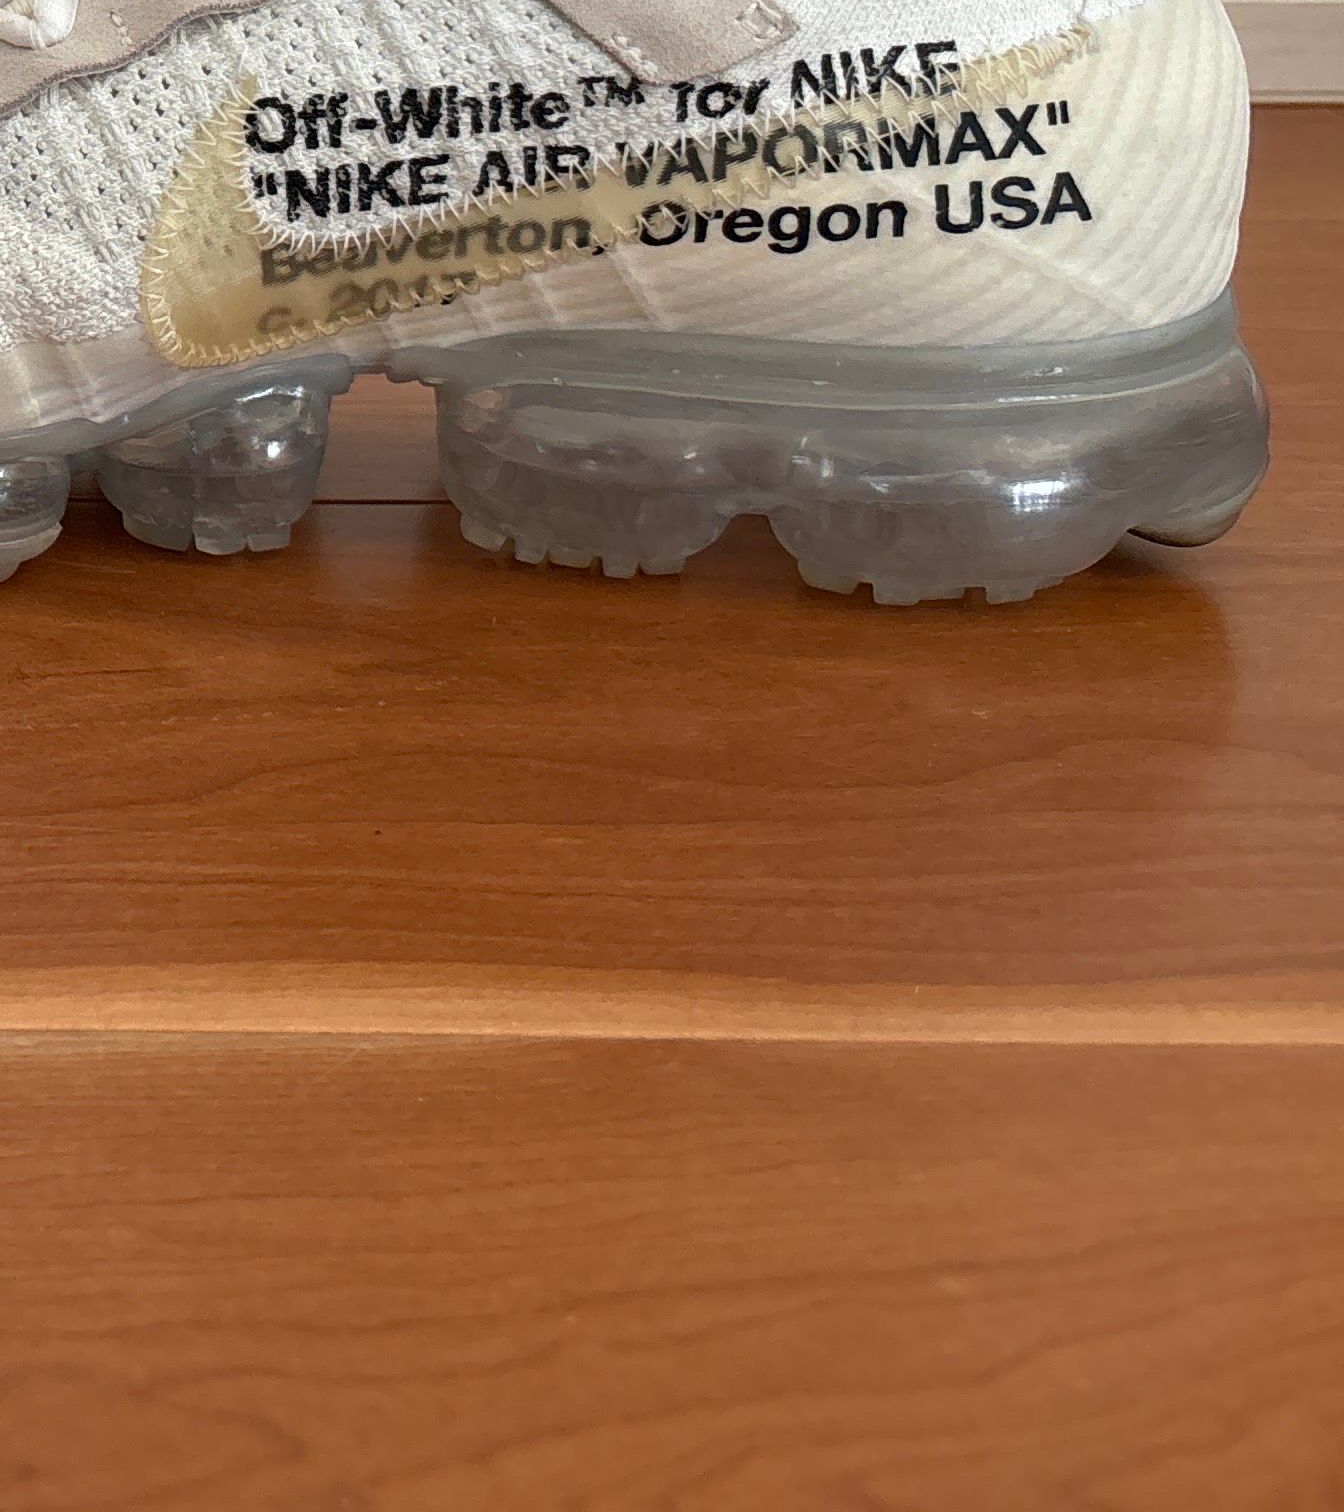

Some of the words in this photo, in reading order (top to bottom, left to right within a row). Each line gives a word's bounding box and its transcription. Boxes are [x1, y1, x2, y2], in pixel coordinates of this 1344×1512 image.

[789, 39, 958, 107] NIKE
[251, 153, 451, 222] "NIKE
[474, 144, 592, 199] AIR
[614, 100, 1069, 187] VAPORMAX"
[638, 199, 909, 254] Oregon
[934, 171, 1092, 234] USA
